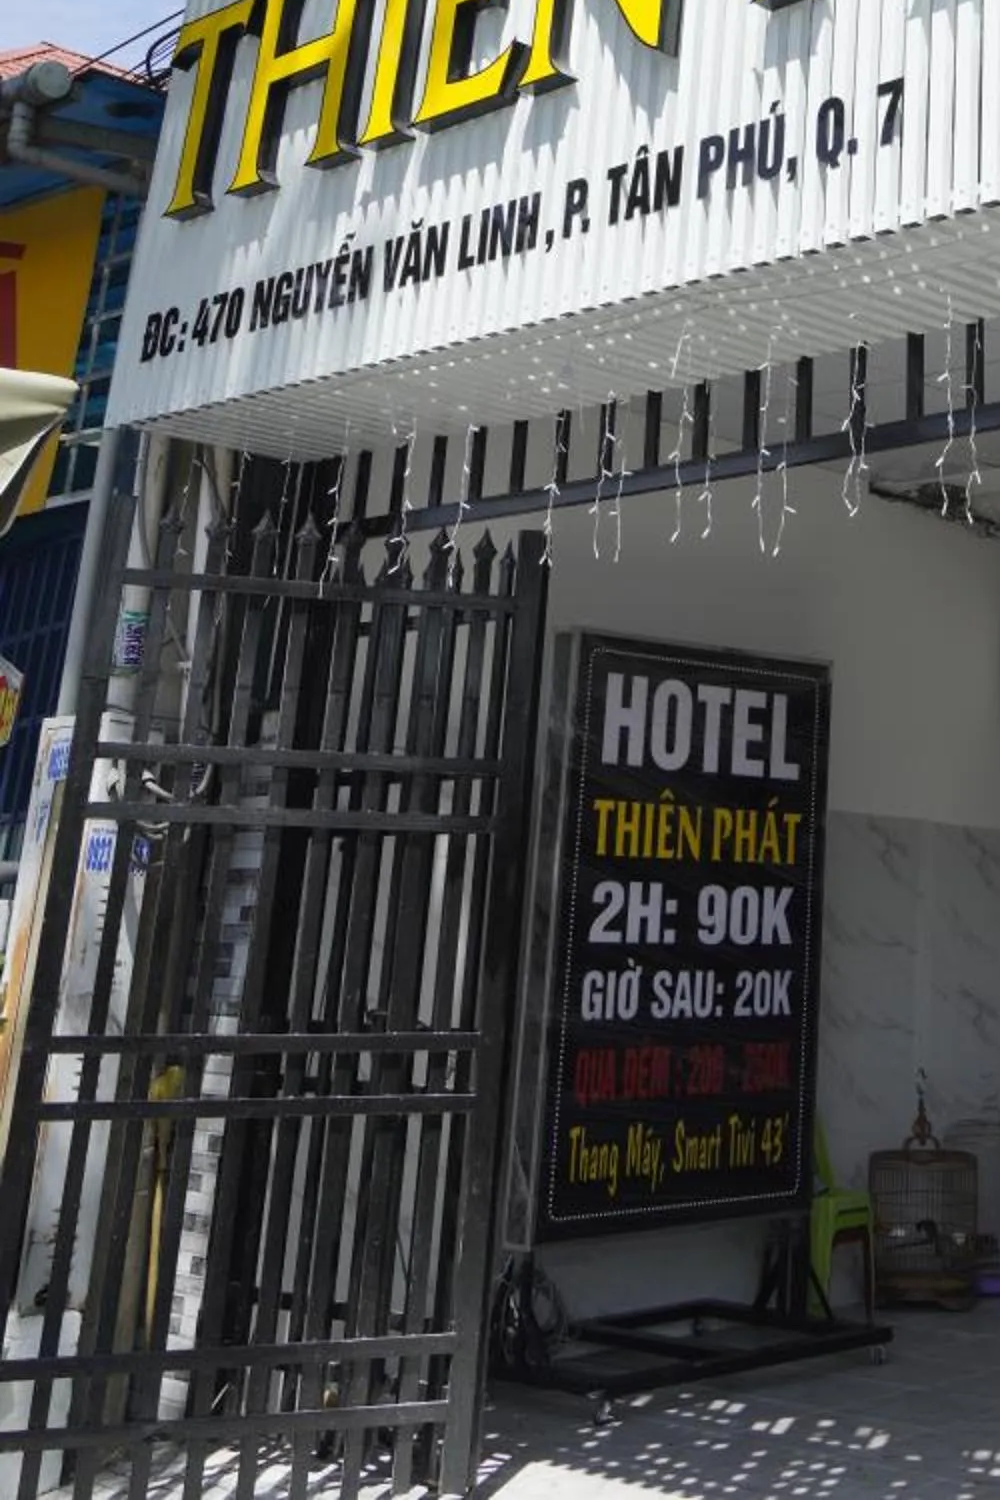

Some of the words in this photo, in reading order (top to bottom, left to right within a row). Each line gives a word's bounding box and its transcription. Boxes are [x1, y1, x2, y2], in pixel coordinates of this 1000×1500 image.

[141, 307, 188, 362] ĐC:
[192, 287, 244, 346] 470
[249, 232, 374, 332] NGUYỄN
[383, 218, 450, 292] VĂN
[563, 177, 591, 238] P.
[608, 144, 684, 225] TÂN
[697, 100, 797, 199] PHÚ,
[816, 97, 857, 167] Q.
[877, 77, 904, 147] 7
[601, 672, 800, 781] HOTEL
[593, 788, 702, 861] THIÊN
[711, 796, 802, 865] PHÁT
[589, 880, 678, 944] 2H:
[697, 884, 794, 944] 90K
[581, 957, 643, 1021] GIỜ
[651, 970, 724, 1019] SAU:
[734, 970, 793, 1017] 20K
[569, 1126, 619, 1197] Thang
[626, 1122, 665, 1193] Máy,
[673, 1119, 722, 1173] Smart
[729, 1113, 756, 1169] Tivi
